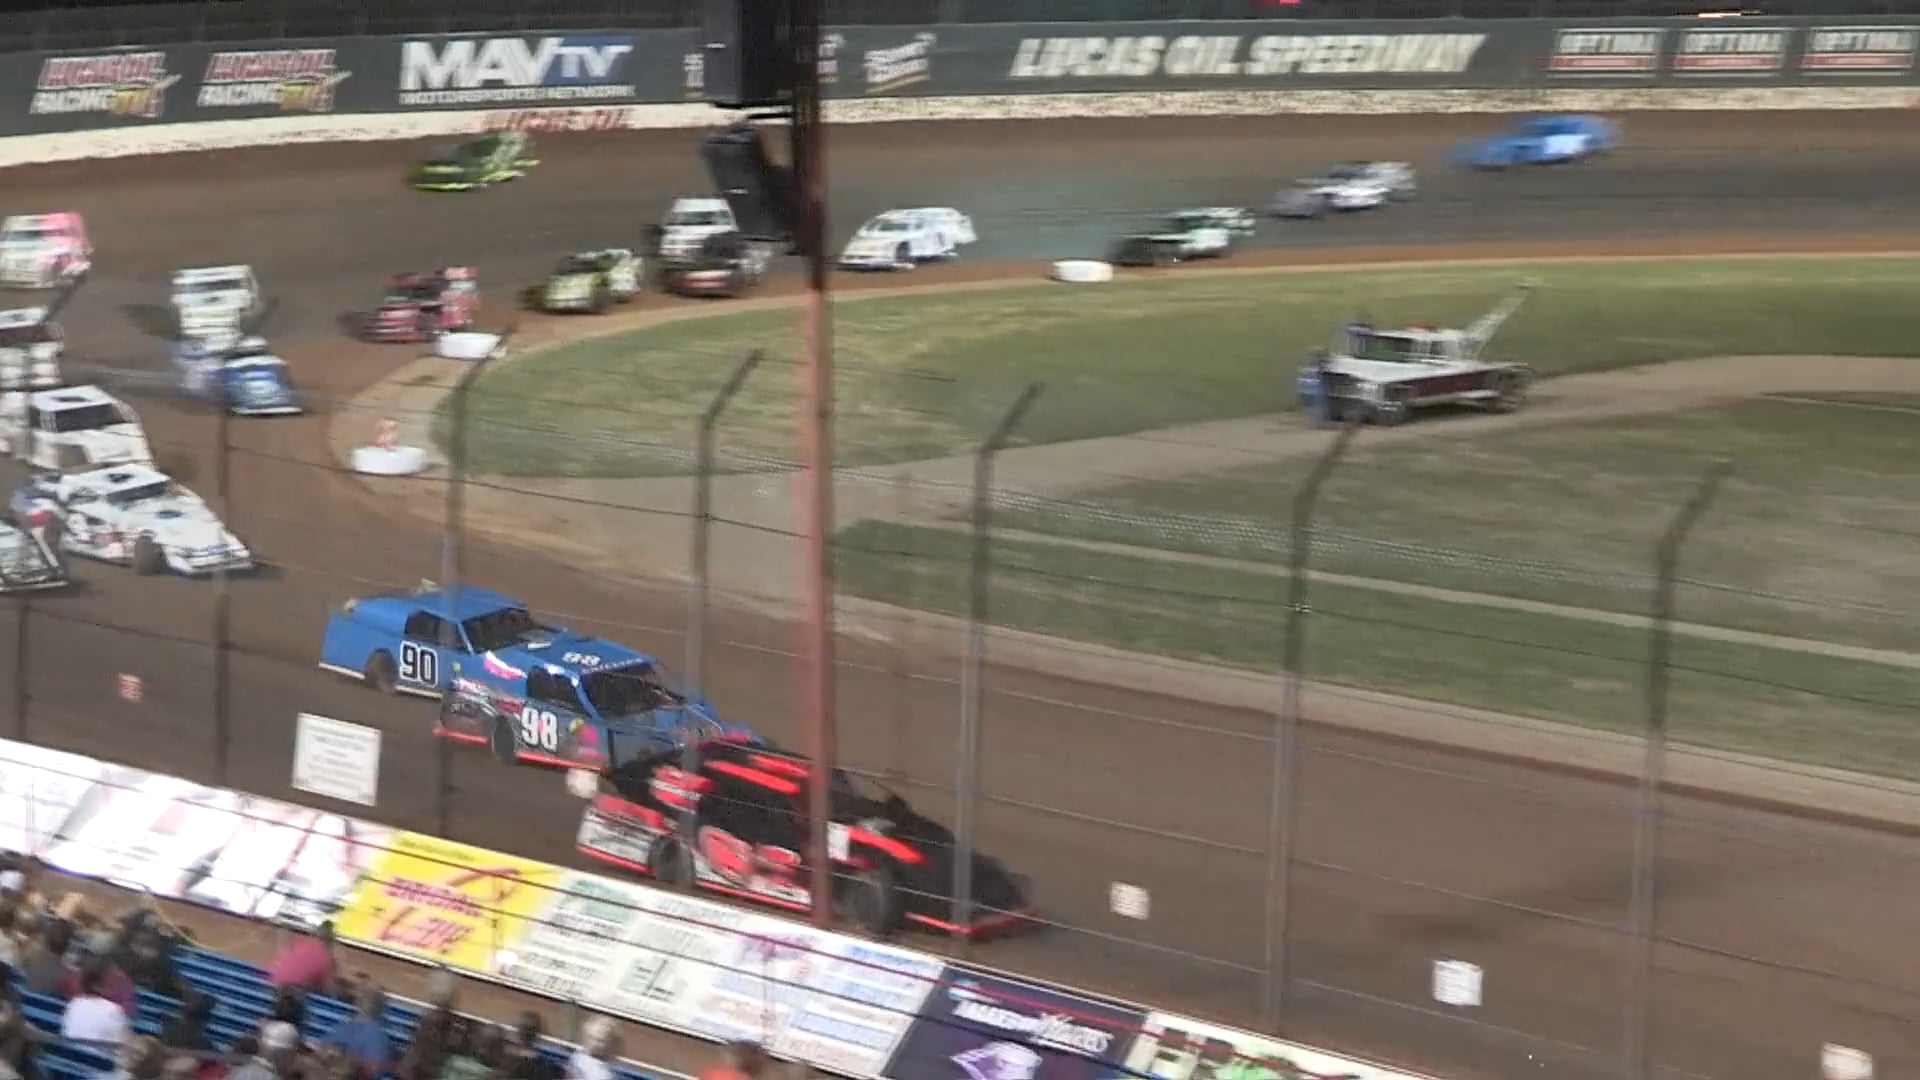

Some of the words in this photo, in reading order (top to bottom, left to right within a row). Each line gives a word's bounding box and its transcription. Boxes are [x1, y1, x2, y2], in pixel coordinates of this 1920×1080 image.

[1009, 36, 1167, 77] LUCAS
[1163, 35, 1243, 75] OIL
[1243, 33, 1488, 75] SPEEDWAY
[400, 640, 438, 688] 90
[521, 706, 557, 752] 98
